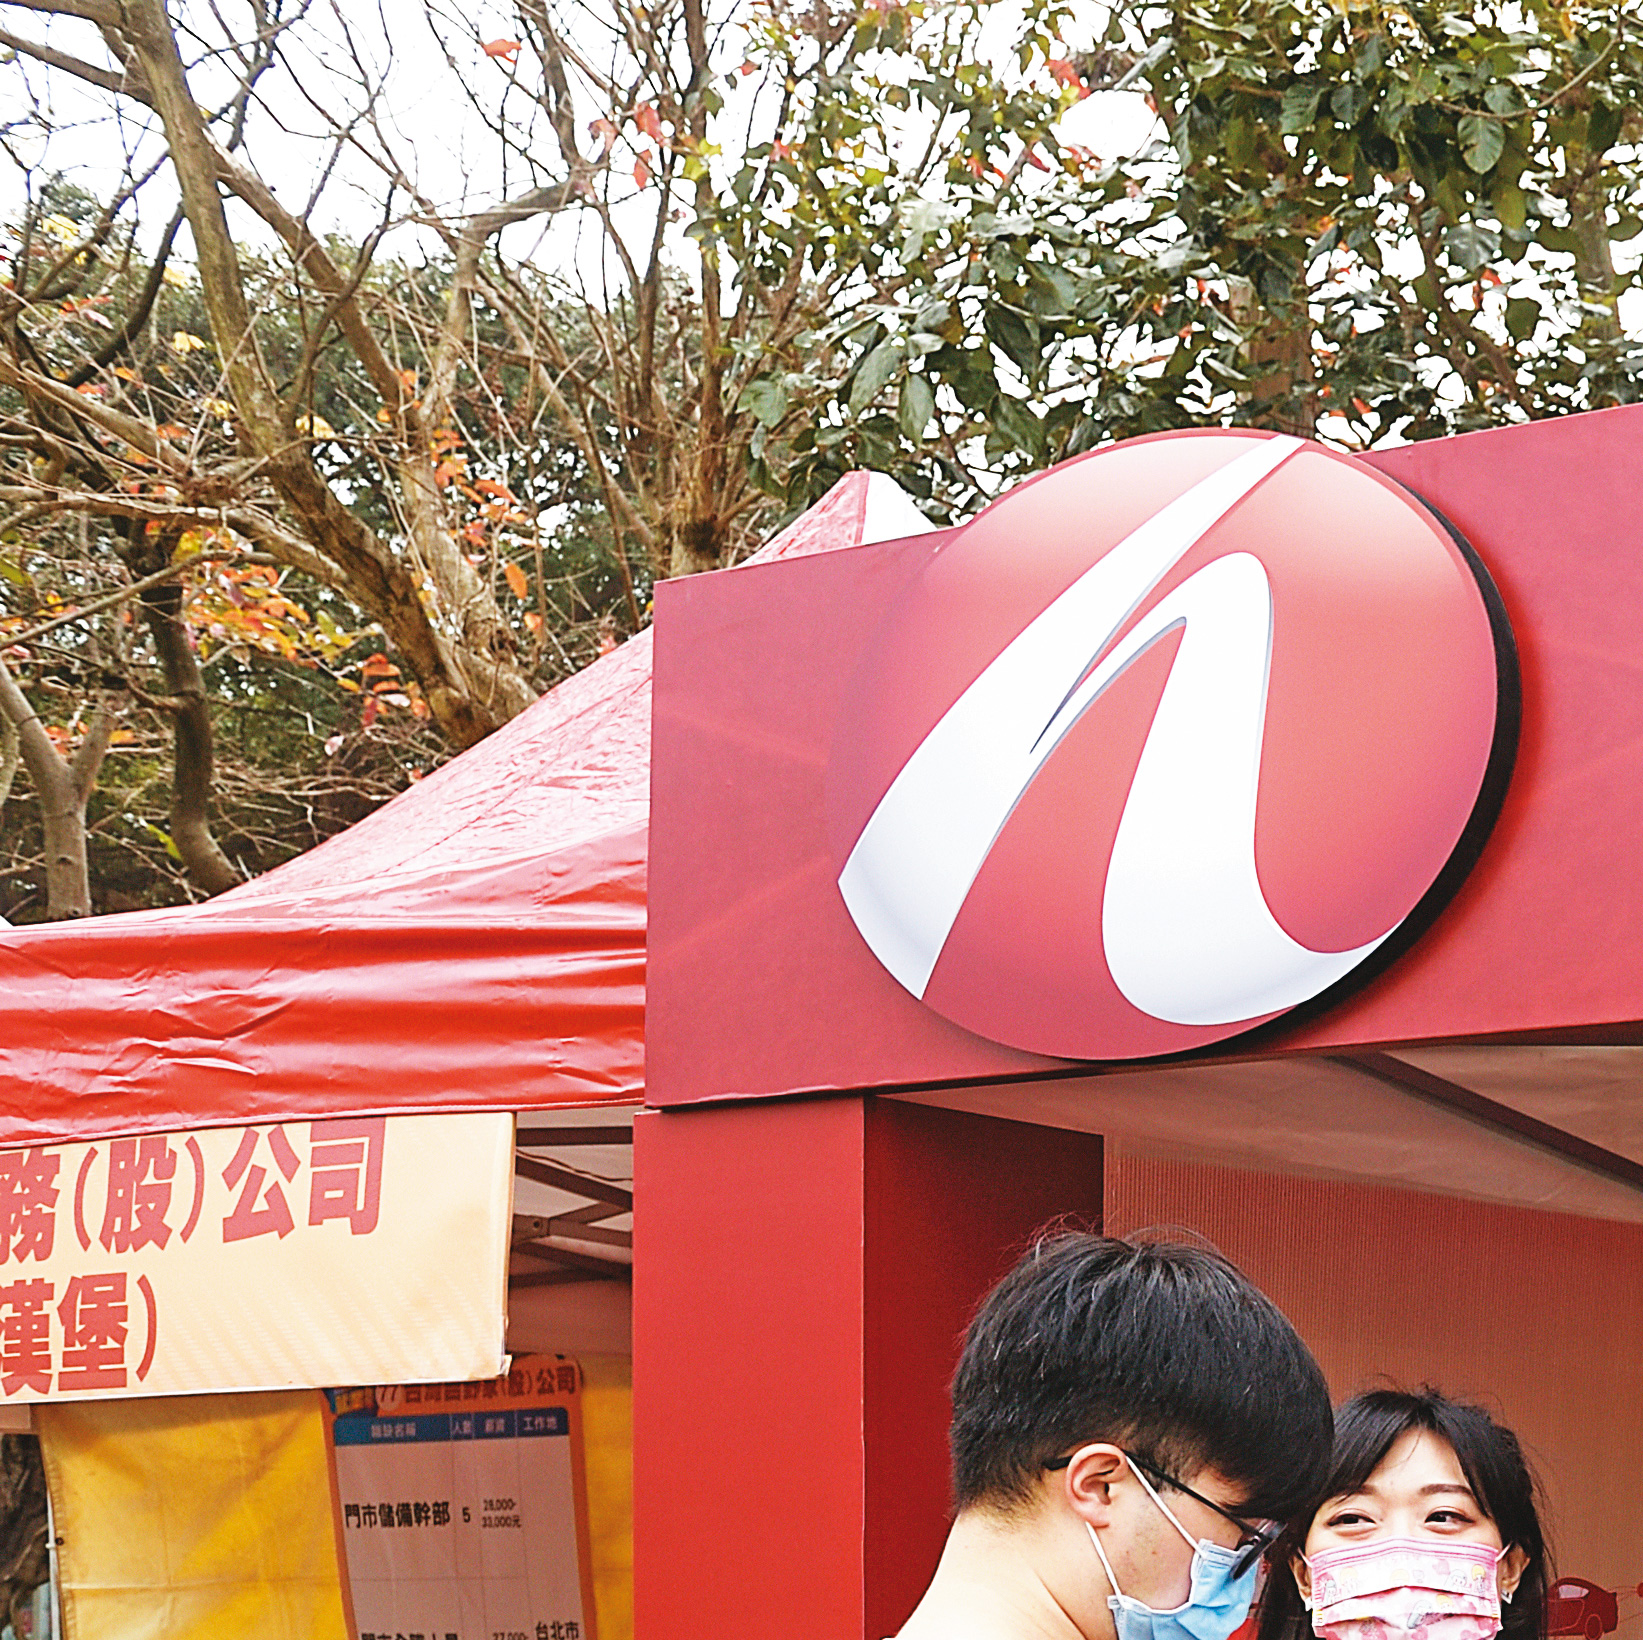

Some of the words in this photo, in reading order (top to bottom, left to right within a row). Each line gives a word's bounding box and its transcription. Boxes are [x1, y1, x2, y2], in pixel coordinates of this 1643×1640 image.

[0, 1117, 387, 1264] 務(股)公司
[0, 1273, 157, 1396] 漢堡)
[344, 1501, 451, 1529] 門市儲備幹部
[462, 1507, 471, 1523] 5
